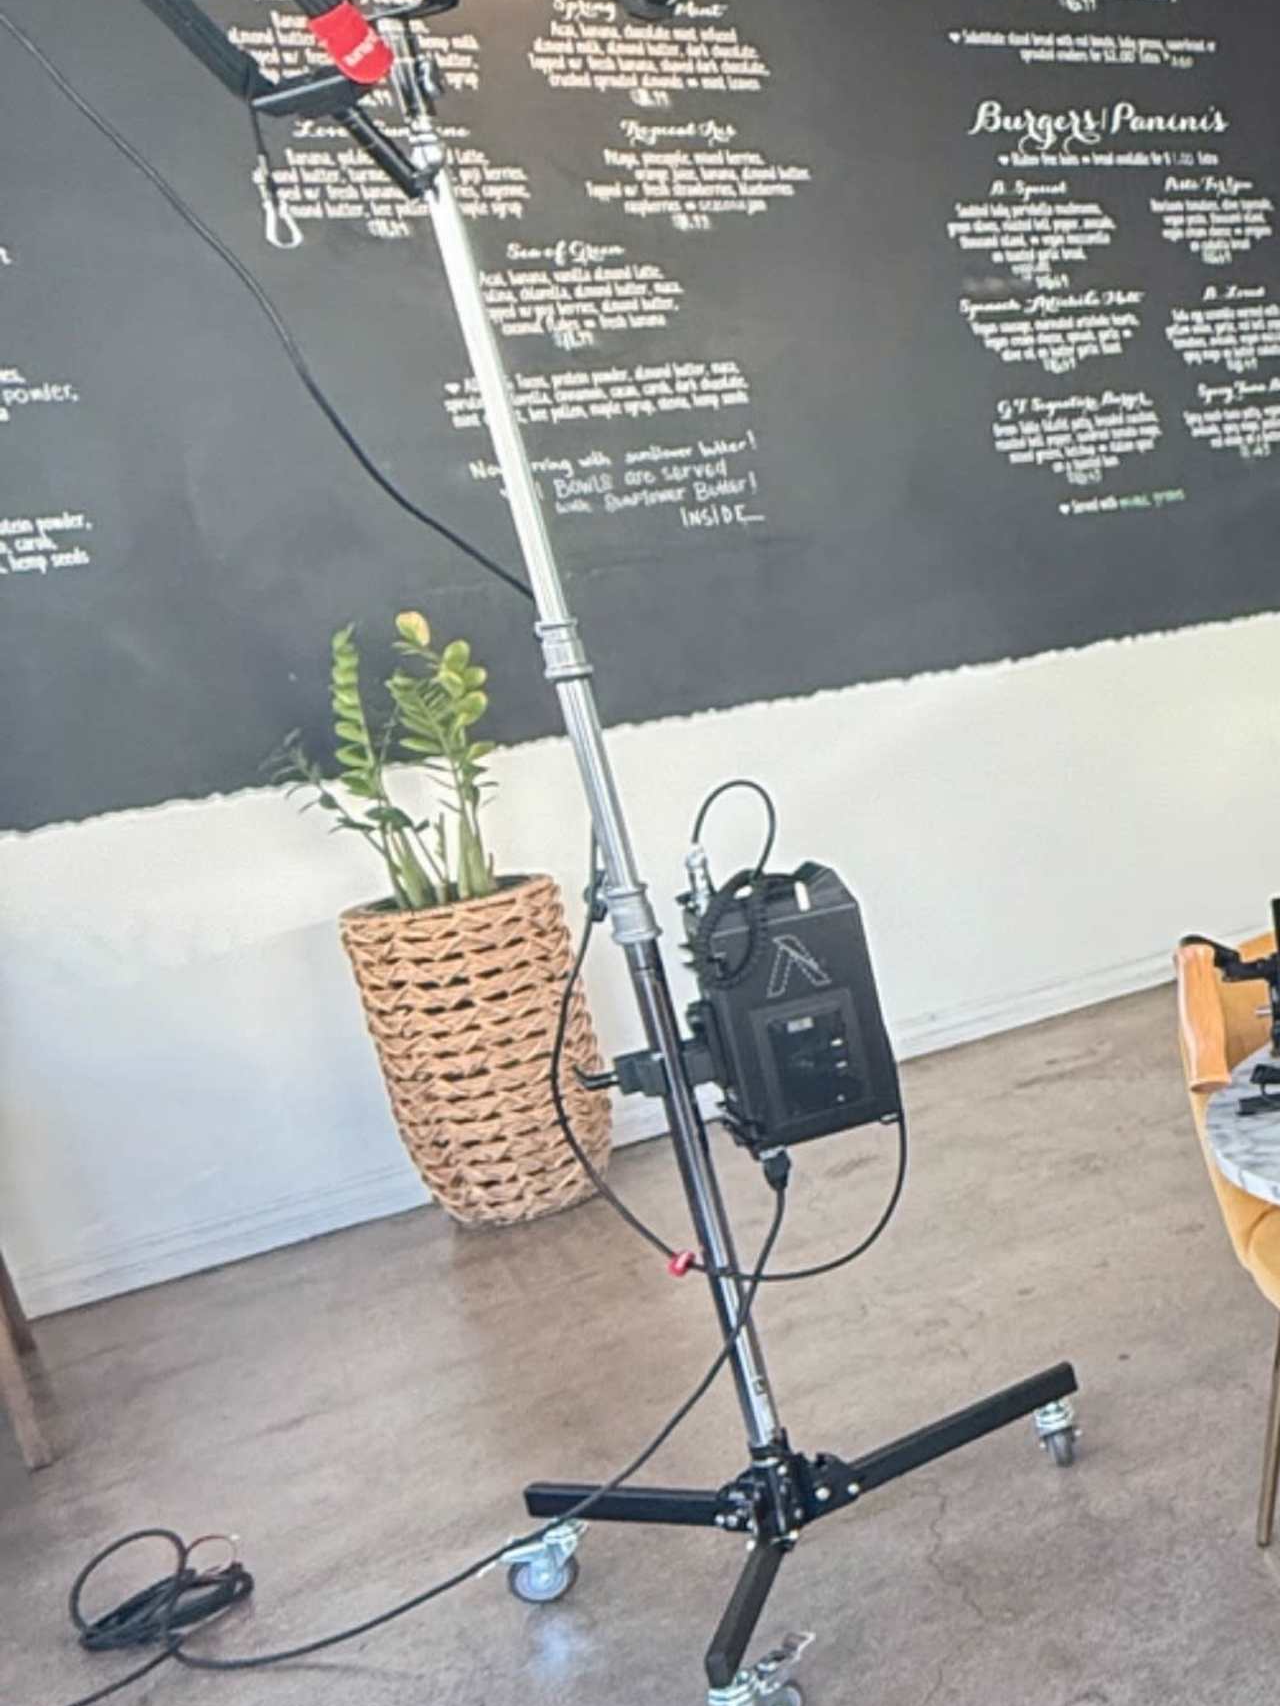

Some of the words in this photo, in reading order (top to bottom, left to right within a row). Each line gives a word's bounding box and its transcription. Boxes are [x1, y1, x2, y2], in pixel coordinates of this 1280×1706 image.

[967, 99, 1102, 155] Burgers
[506, 242, 541, 261] Sea
[531, 456, 575, 479] rving
[660, 459, 728, 481] served
[680, 502, 748, 527] INSIDE
